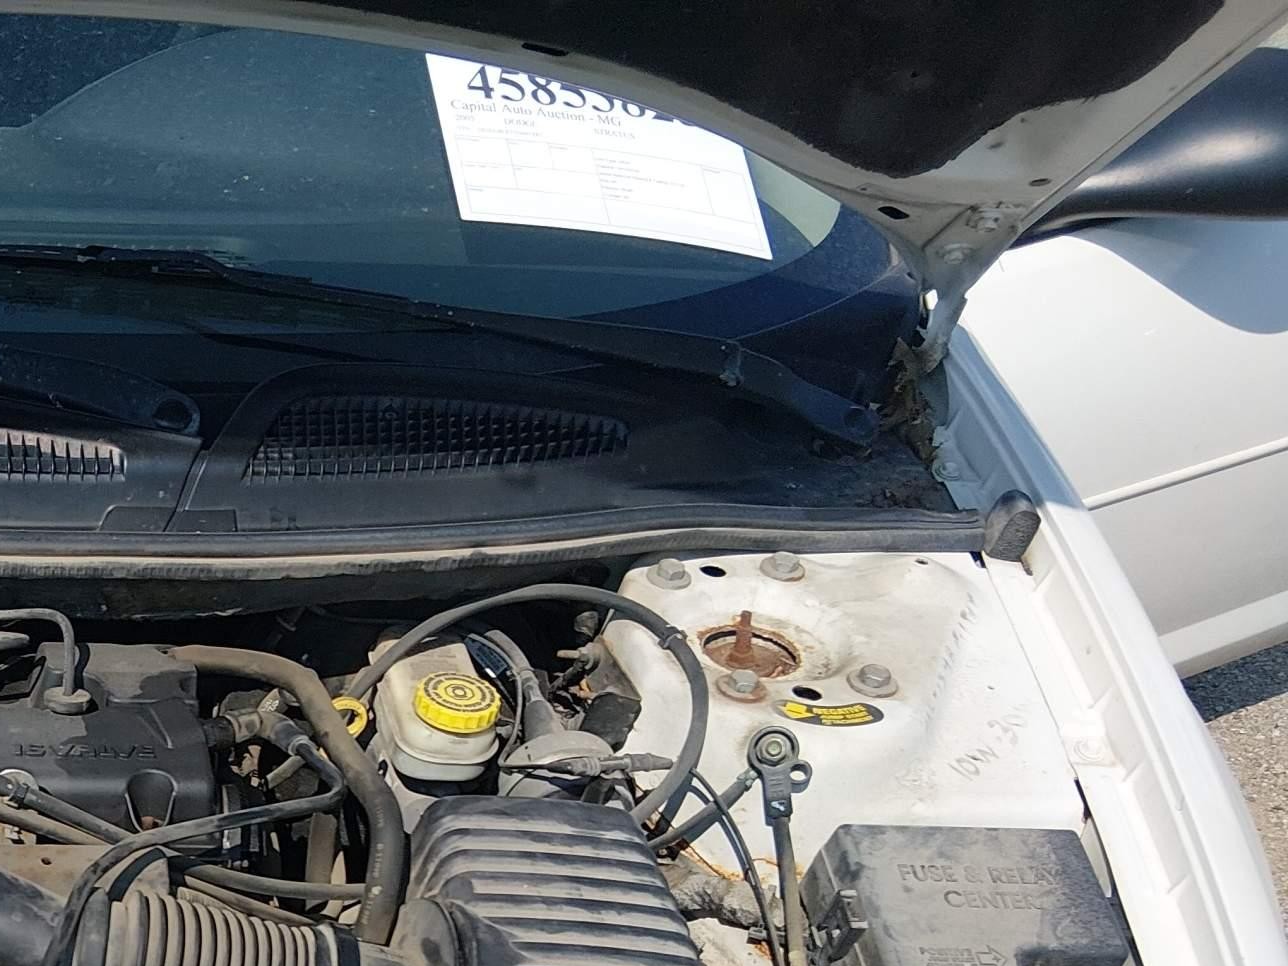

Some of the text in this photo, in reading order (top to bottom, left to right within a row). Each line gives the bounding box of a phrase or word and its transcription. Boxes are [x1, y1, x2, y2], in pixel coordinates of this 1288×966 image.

[450, 99, 497, 114] Capital
[502, 103, 533, 116] Auto
[536, 107, 585, 123] Auction
[597, 114, 622, 127] MG
[896, 863, 1060, 886] FUSE & RELAY
[943, 890, 1045, 911] CENTER
